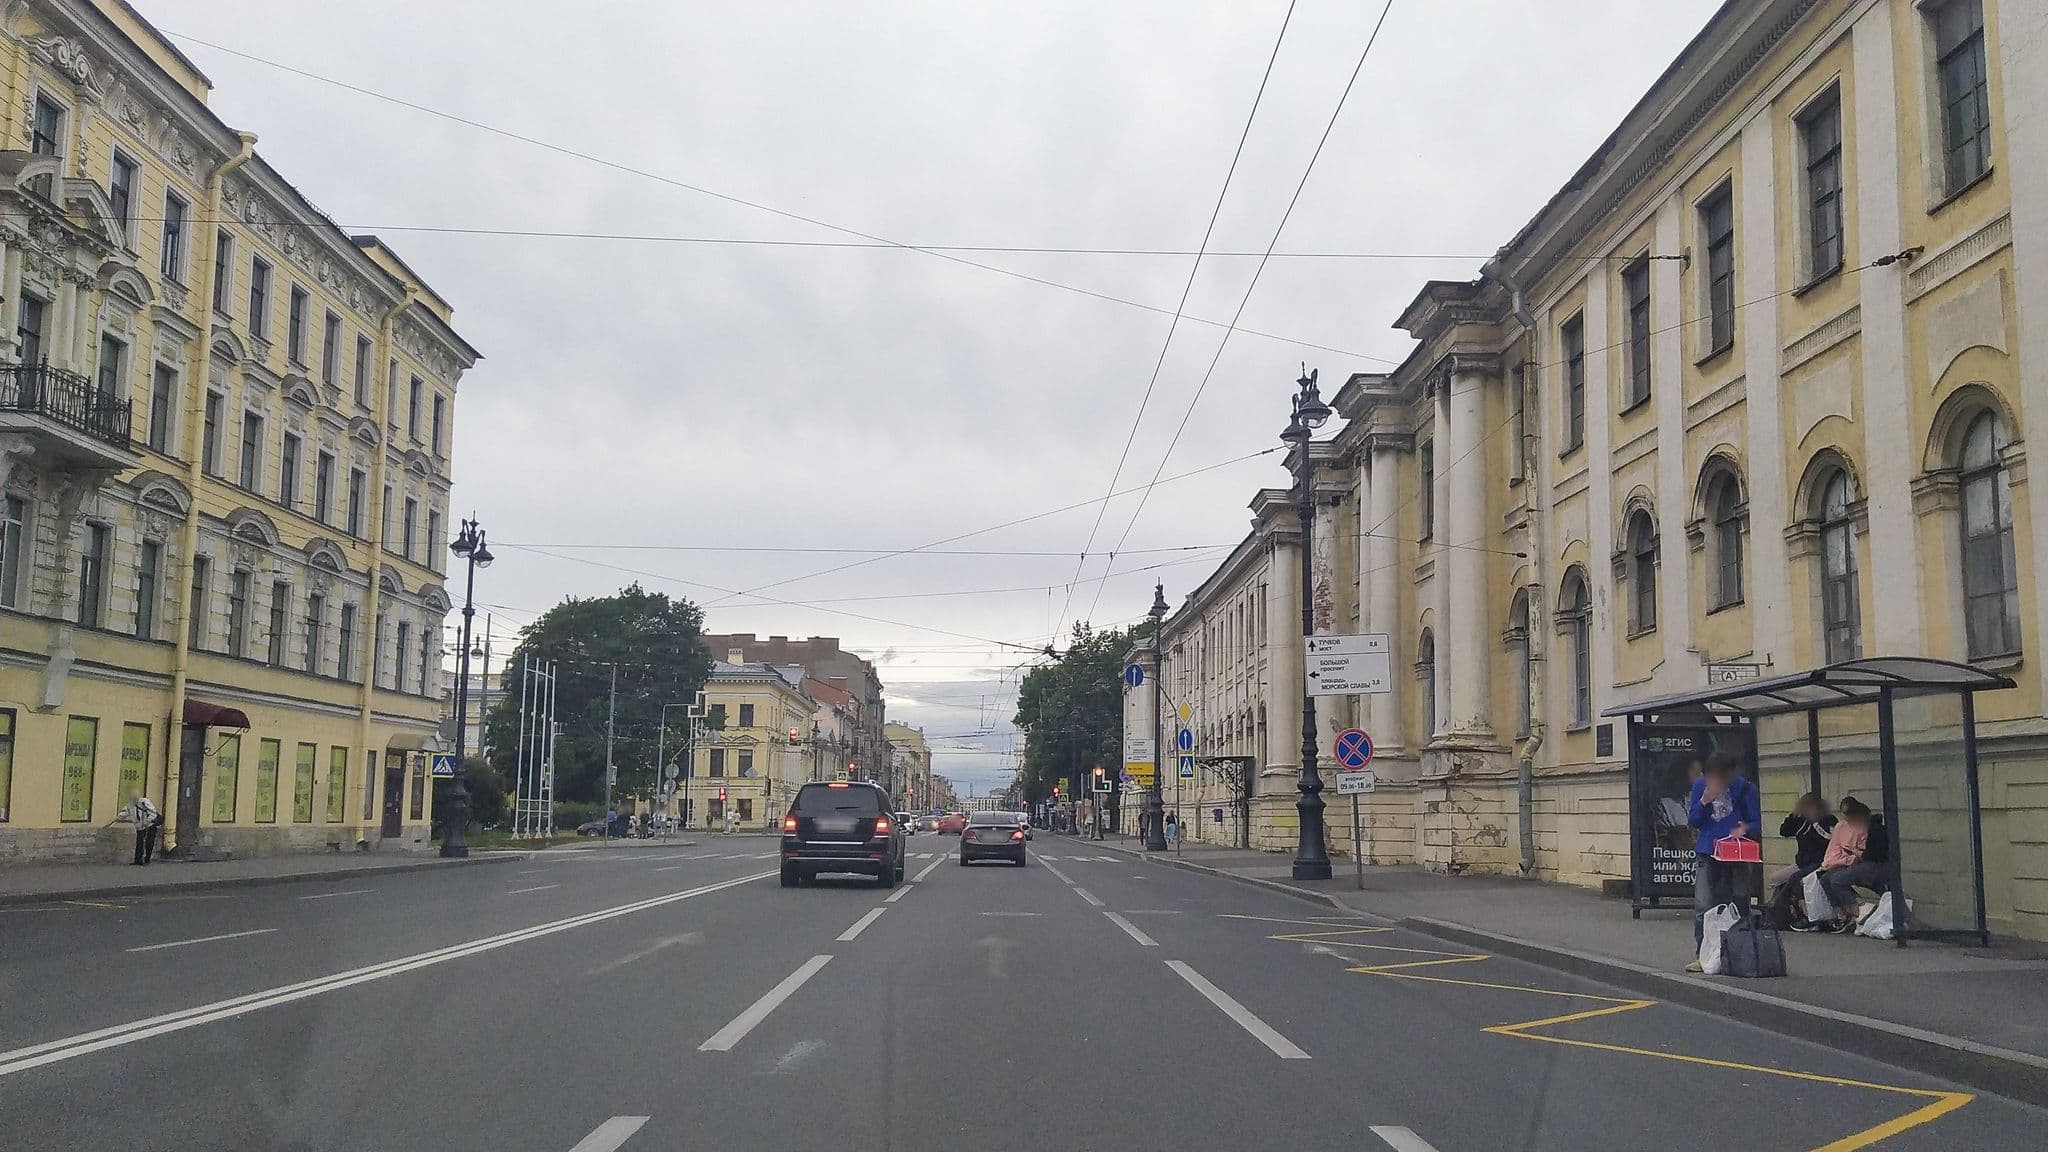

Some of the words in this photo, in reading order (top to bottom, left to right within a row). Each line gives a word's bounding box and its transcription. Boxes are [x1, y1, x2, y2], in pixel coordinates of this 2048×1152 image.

[1320, 658, 1350, 666] БОЛЬШОЙ
[1665, 738, 1692, 747] 2ГИС
[1653, 847, 1697, 858] Пешко
[1653, 862, 1677, 870] или
[1653, 872, 1697, 885] автобу
